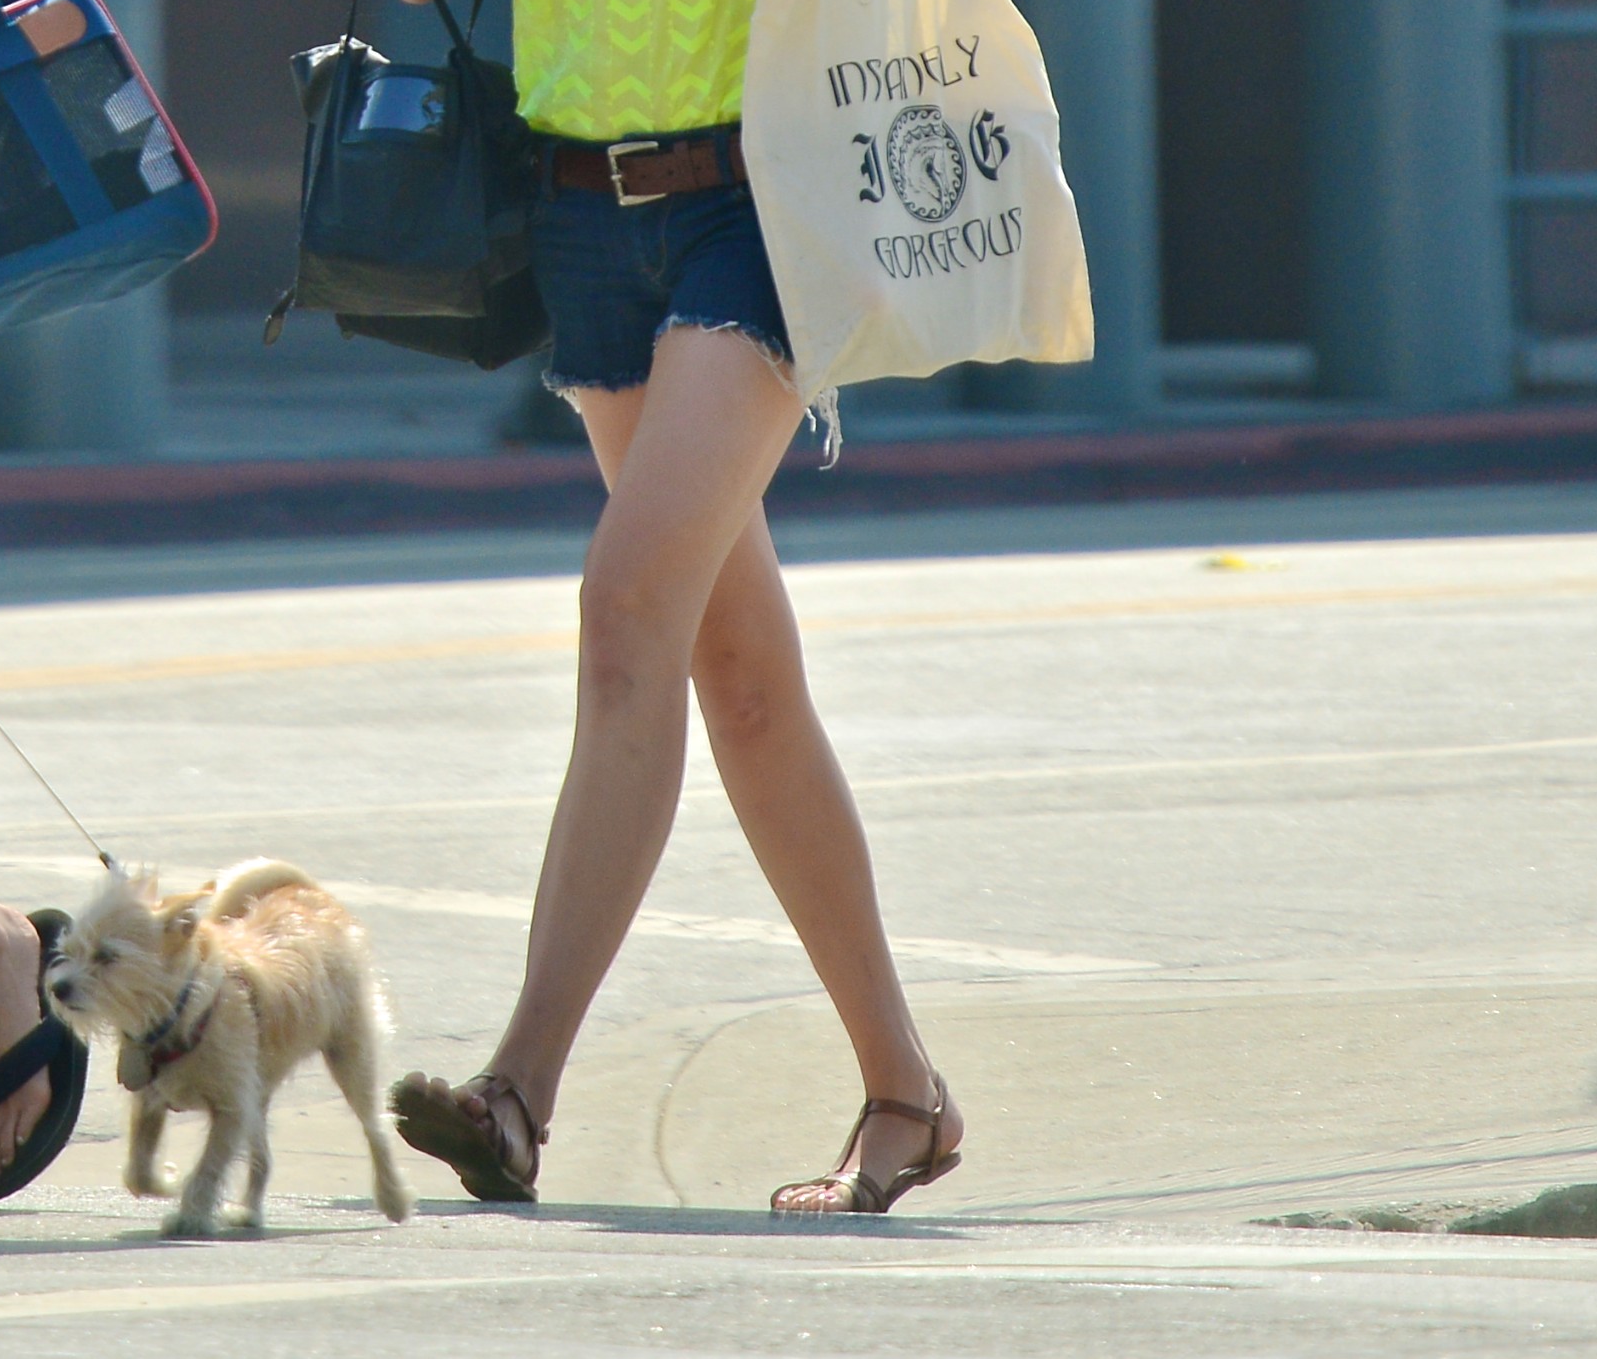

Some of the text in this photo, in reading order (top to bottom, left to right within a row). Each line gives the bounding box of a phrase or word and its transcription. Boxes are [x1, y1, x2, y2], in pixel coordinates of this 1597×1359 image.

[827, 35, 979, 107] INSANELY
[969, 108, 1011, 181] G
[874, 207, 1022, 279] GORGEOUS
